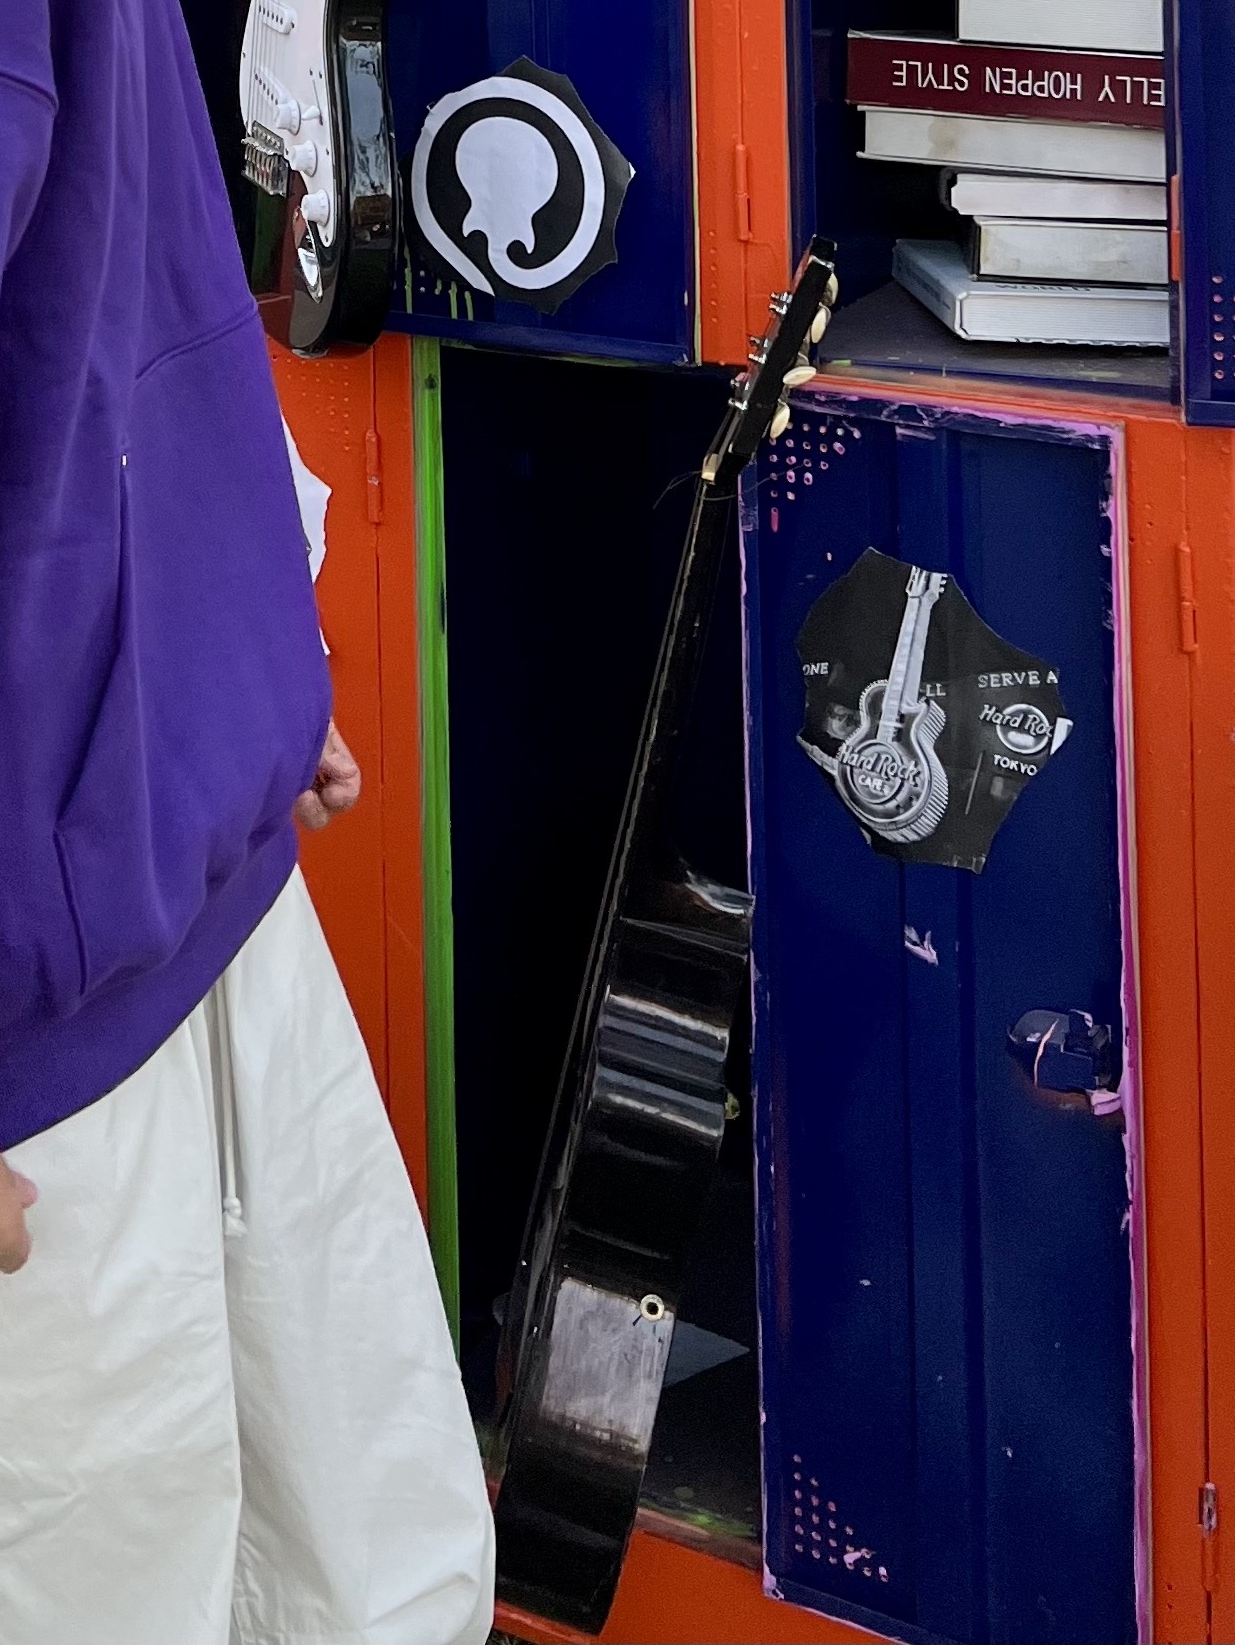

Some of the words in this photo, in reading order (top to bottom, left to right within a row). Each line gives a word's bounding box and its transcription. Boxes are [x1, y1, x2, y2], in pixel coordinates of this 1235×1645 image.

[892, 59, 969, 92] STYLE
[986, 66, 1082, 102] HOPPEN
[1097, 74, 1165, 107] ELLY
[978, 670, 1041, 688] SERVE
[1046, 670, 1059, 684] A
[979, 704, 1024, 728] Hard
[839, 742, 879, 772] Hard
[876, 753, 922, 787] Rock
[992, 754, 1038, 776] TOKYO
